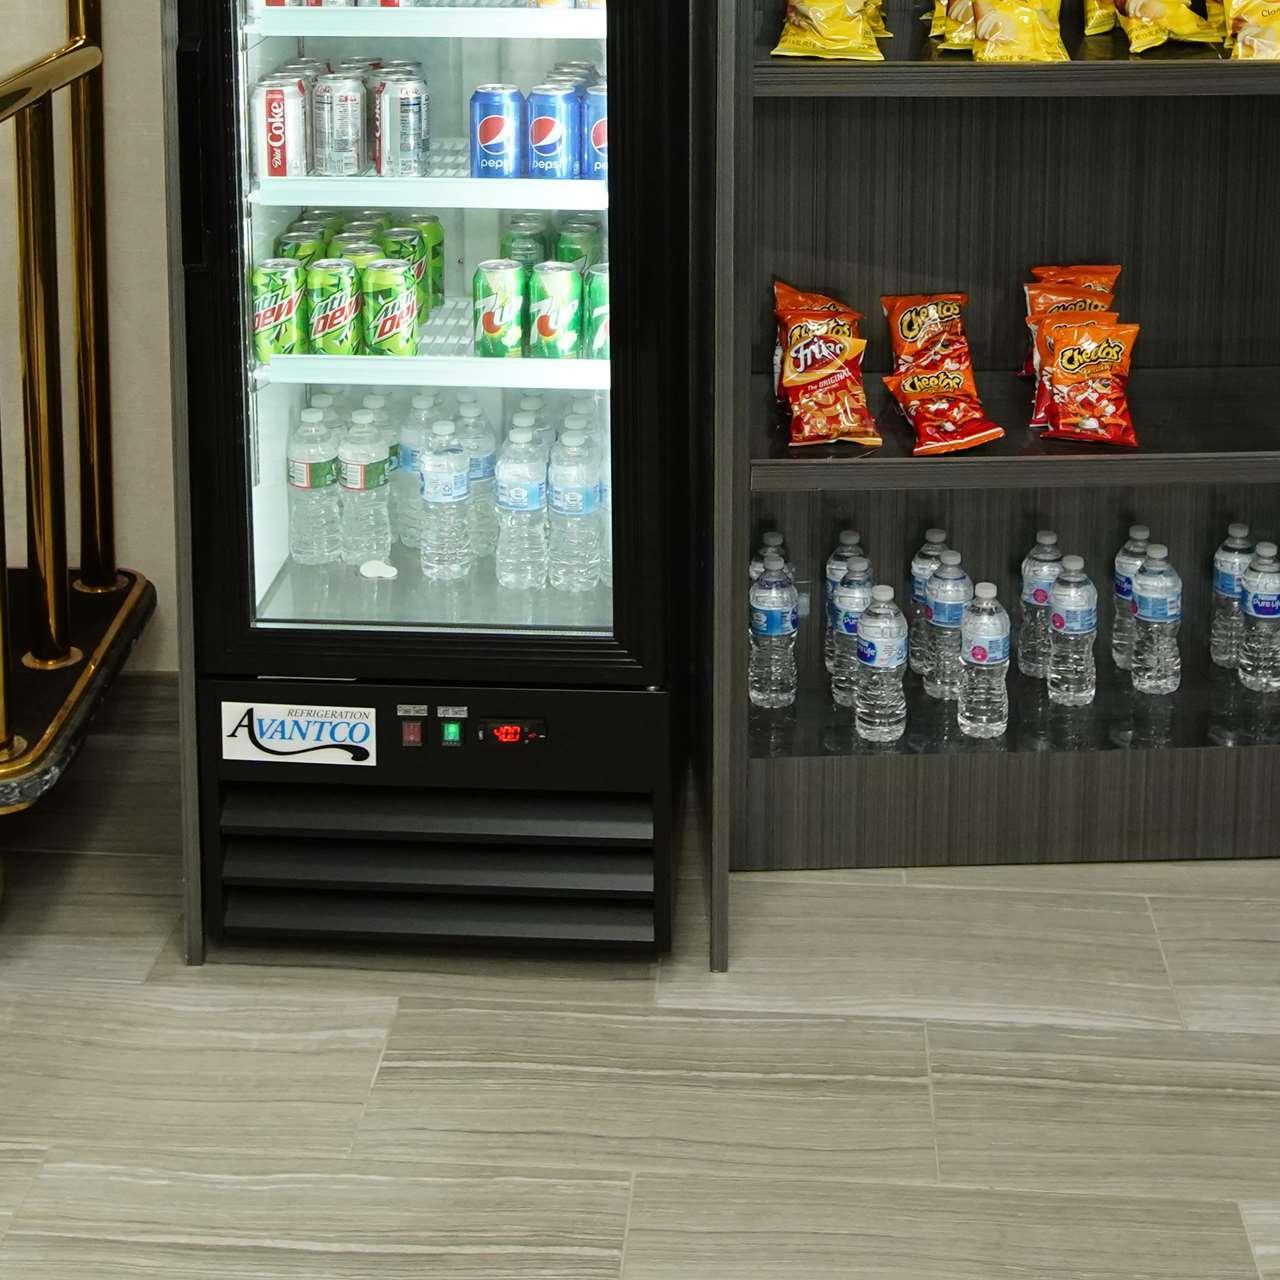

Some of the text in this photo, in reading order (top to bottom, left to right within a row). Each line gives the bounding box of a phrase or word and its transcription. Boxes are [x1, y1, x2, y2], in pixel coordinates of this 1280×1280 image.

[267, 100, 285, 147] Coke
[1060, 338, 1124, 373] Cheetos
[226, 707, 371, 748] AVANTCO
[288, 708, 371, 720] REFRIGERATION
